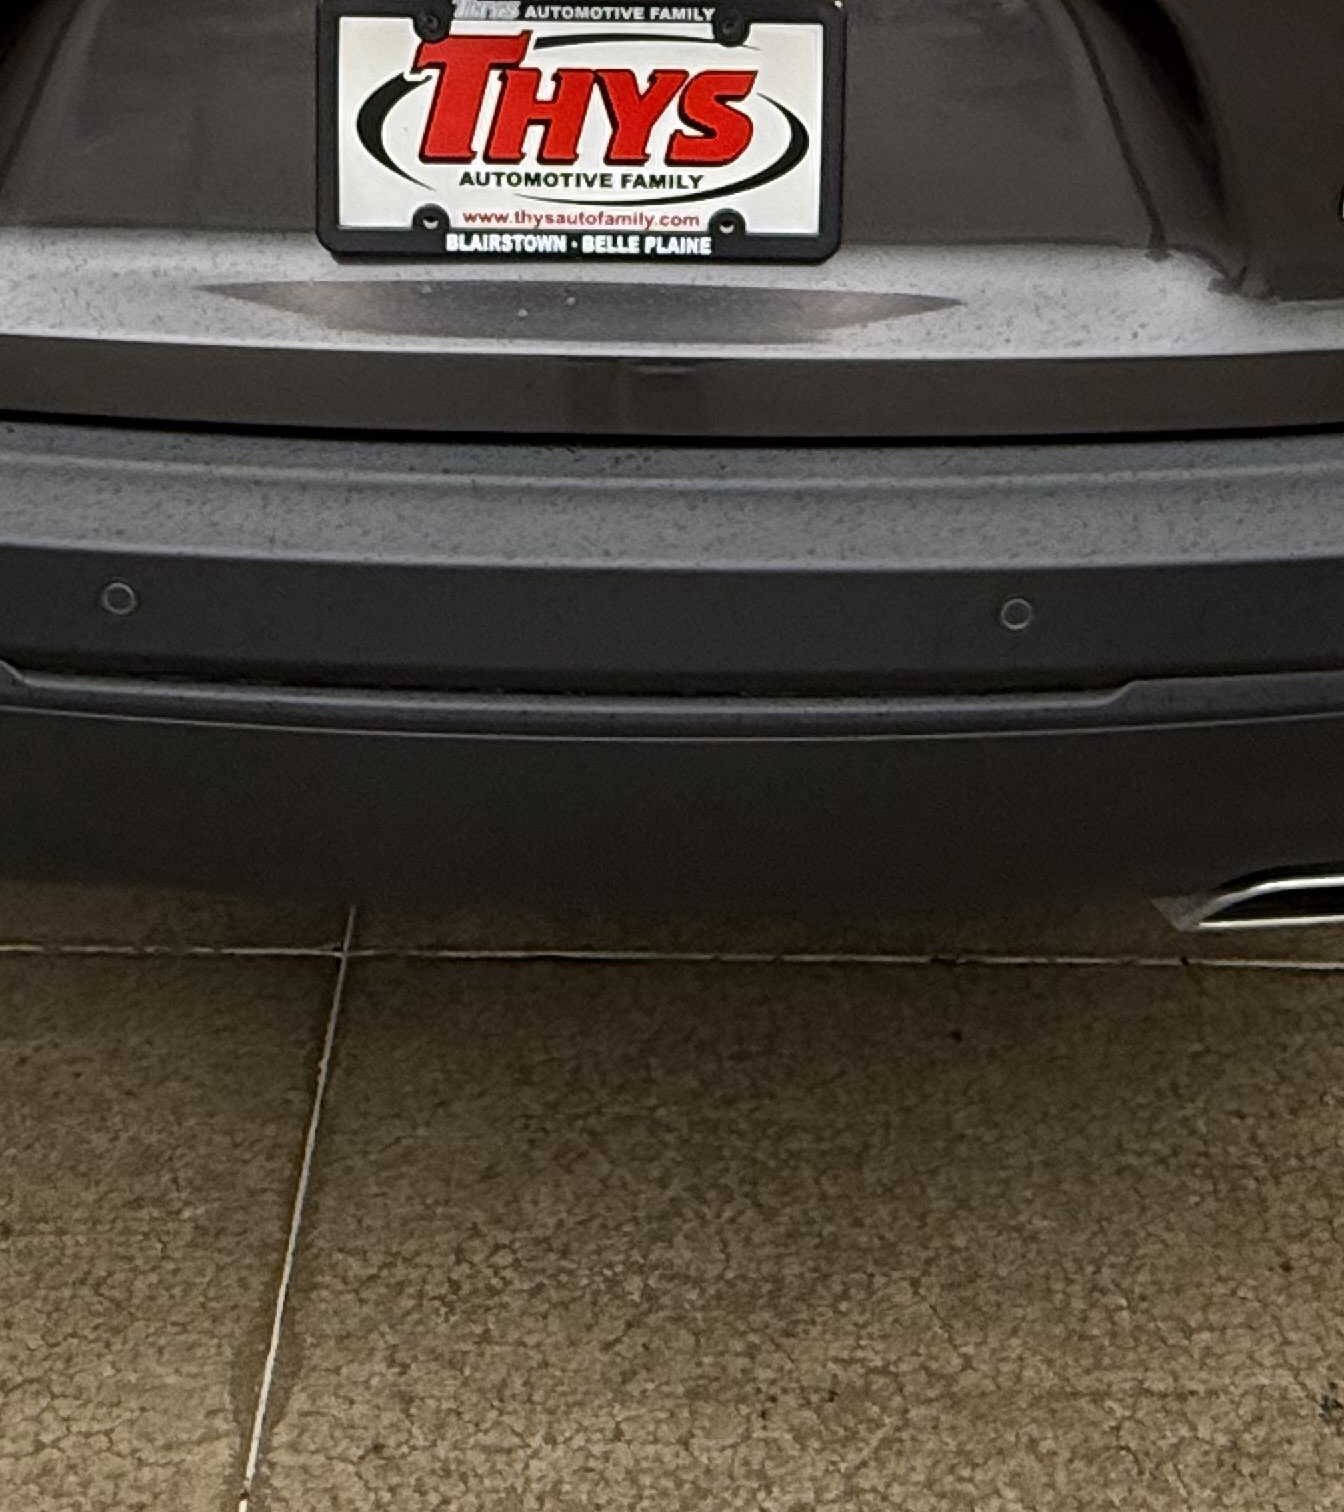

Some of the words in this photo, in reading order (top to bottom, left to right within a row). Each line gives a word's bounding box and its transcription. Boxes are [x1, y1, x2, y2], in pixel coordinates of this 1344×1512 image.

[524, 5, 645, 20] AUTOMOTIVE
[650, 6, 716, 22] FAMILY
[410, 30, 758, 167] THYS
[458, 171, 614, 189] AUTOMOTIVE
[620, 173, 705, 190] FAMILY
[462, 209, 700, 230] www.thysautofamily.com
[445, 233, 568, 253] BLAIRSTOWN
[581, 235, 640, 254] BELLE
[644, 236, 712, 255] PLAINE
